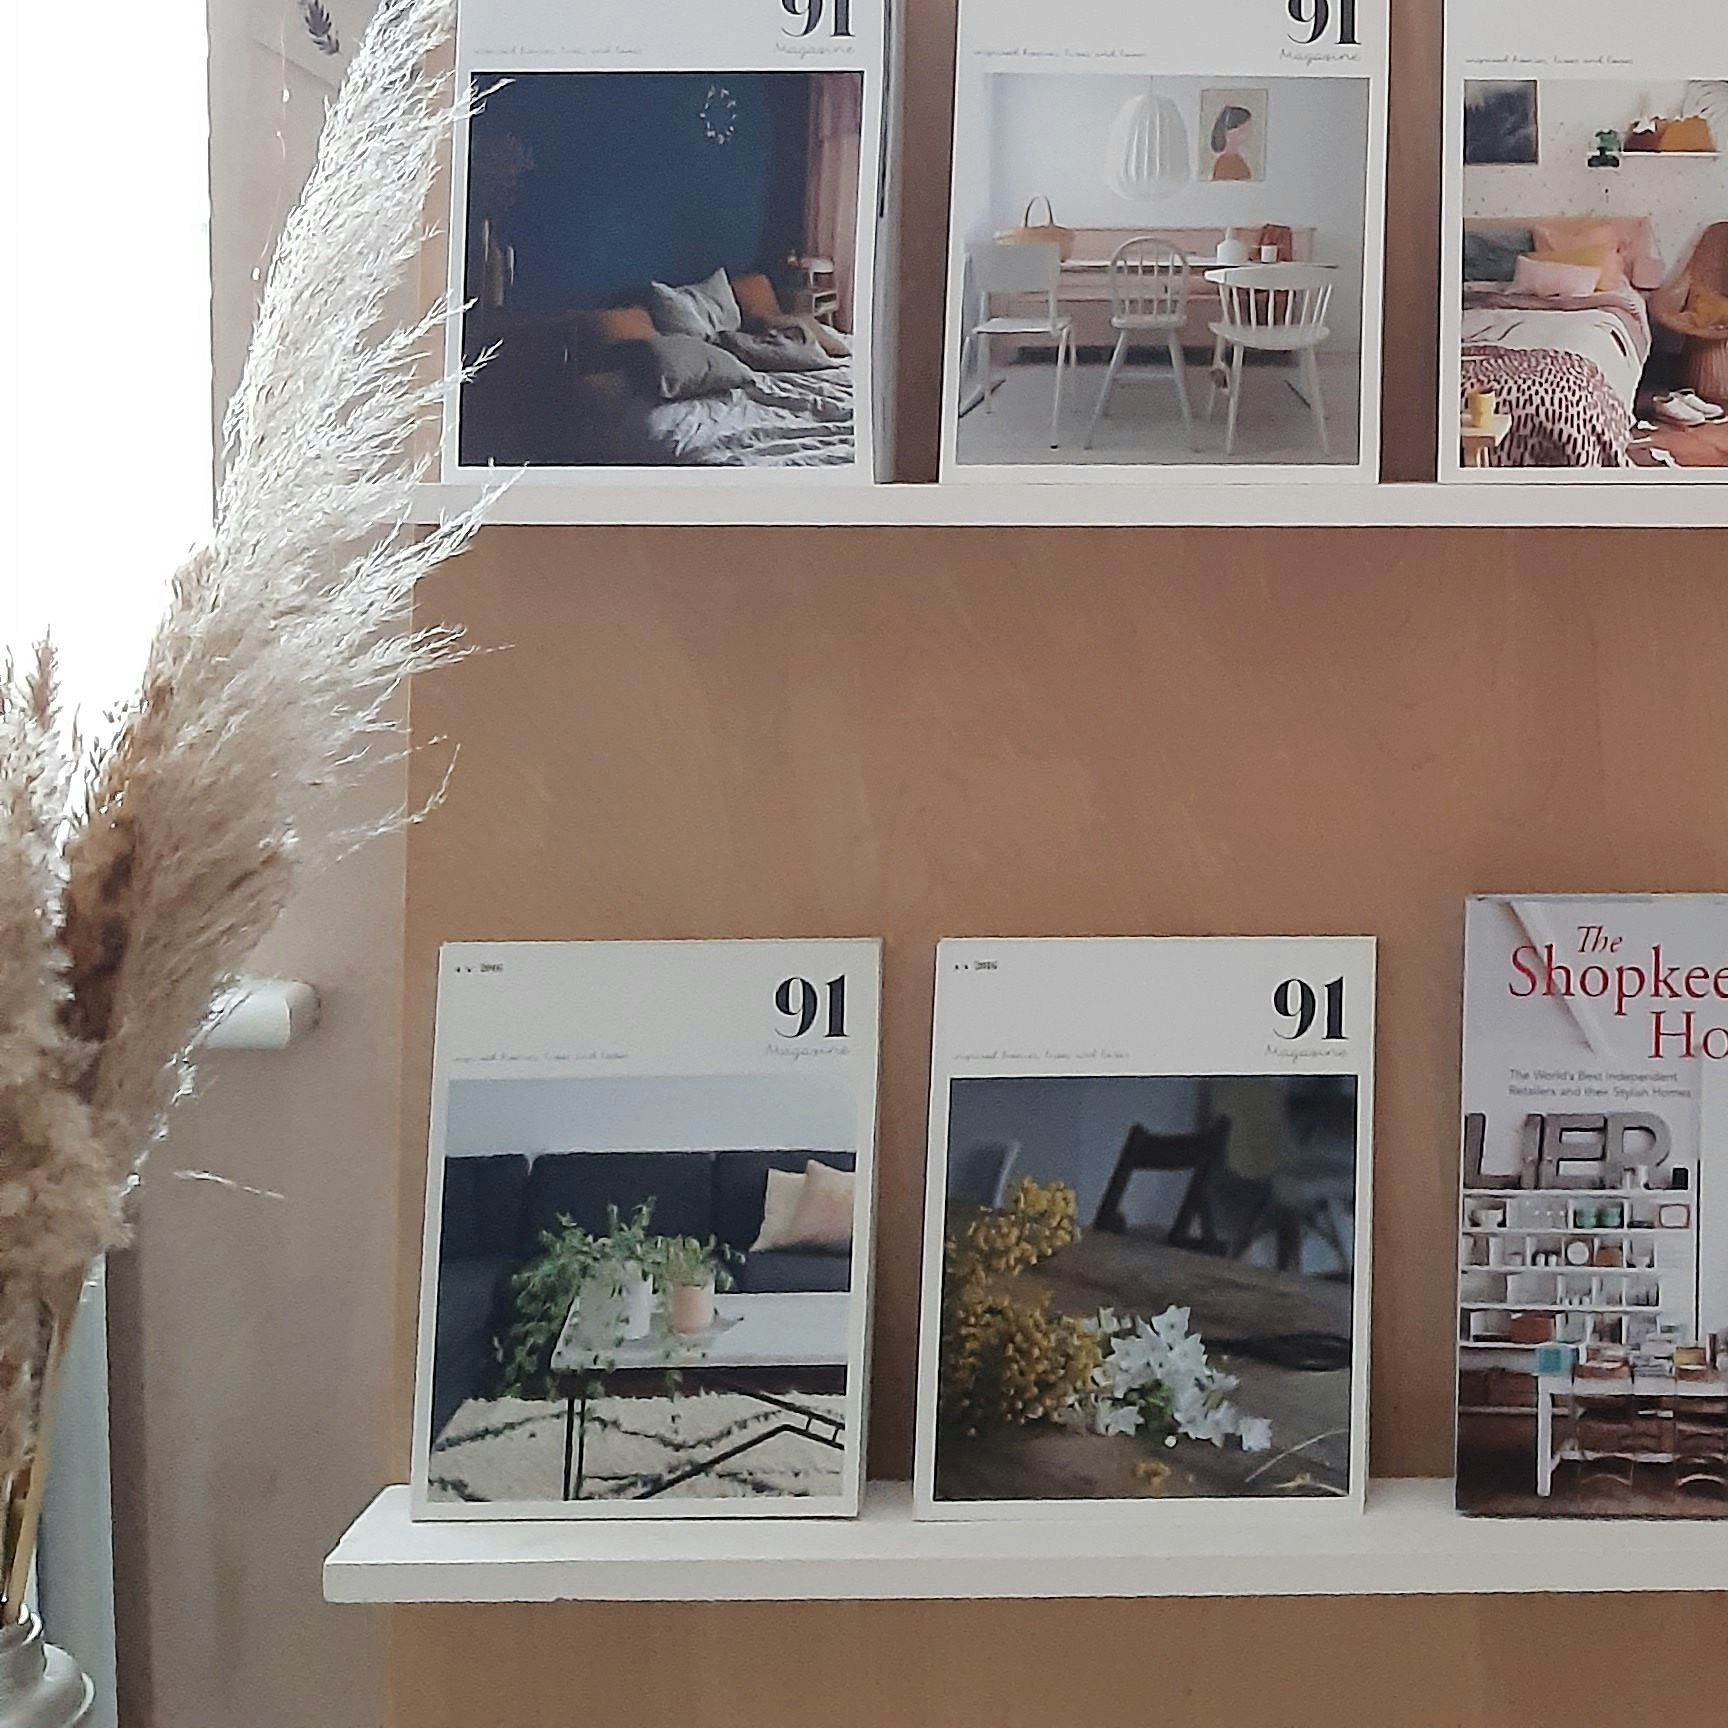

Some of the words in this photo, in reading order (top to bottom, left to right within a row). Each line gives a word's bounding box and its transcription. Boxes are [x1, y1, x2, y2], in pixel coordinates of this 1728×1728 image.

[1577, 925, 1623, 954] The
[775, 975, 847, 1038] 91
[1274, 977, 1348, 1040] 91
[1560, 1085, 1581, 1097] and
